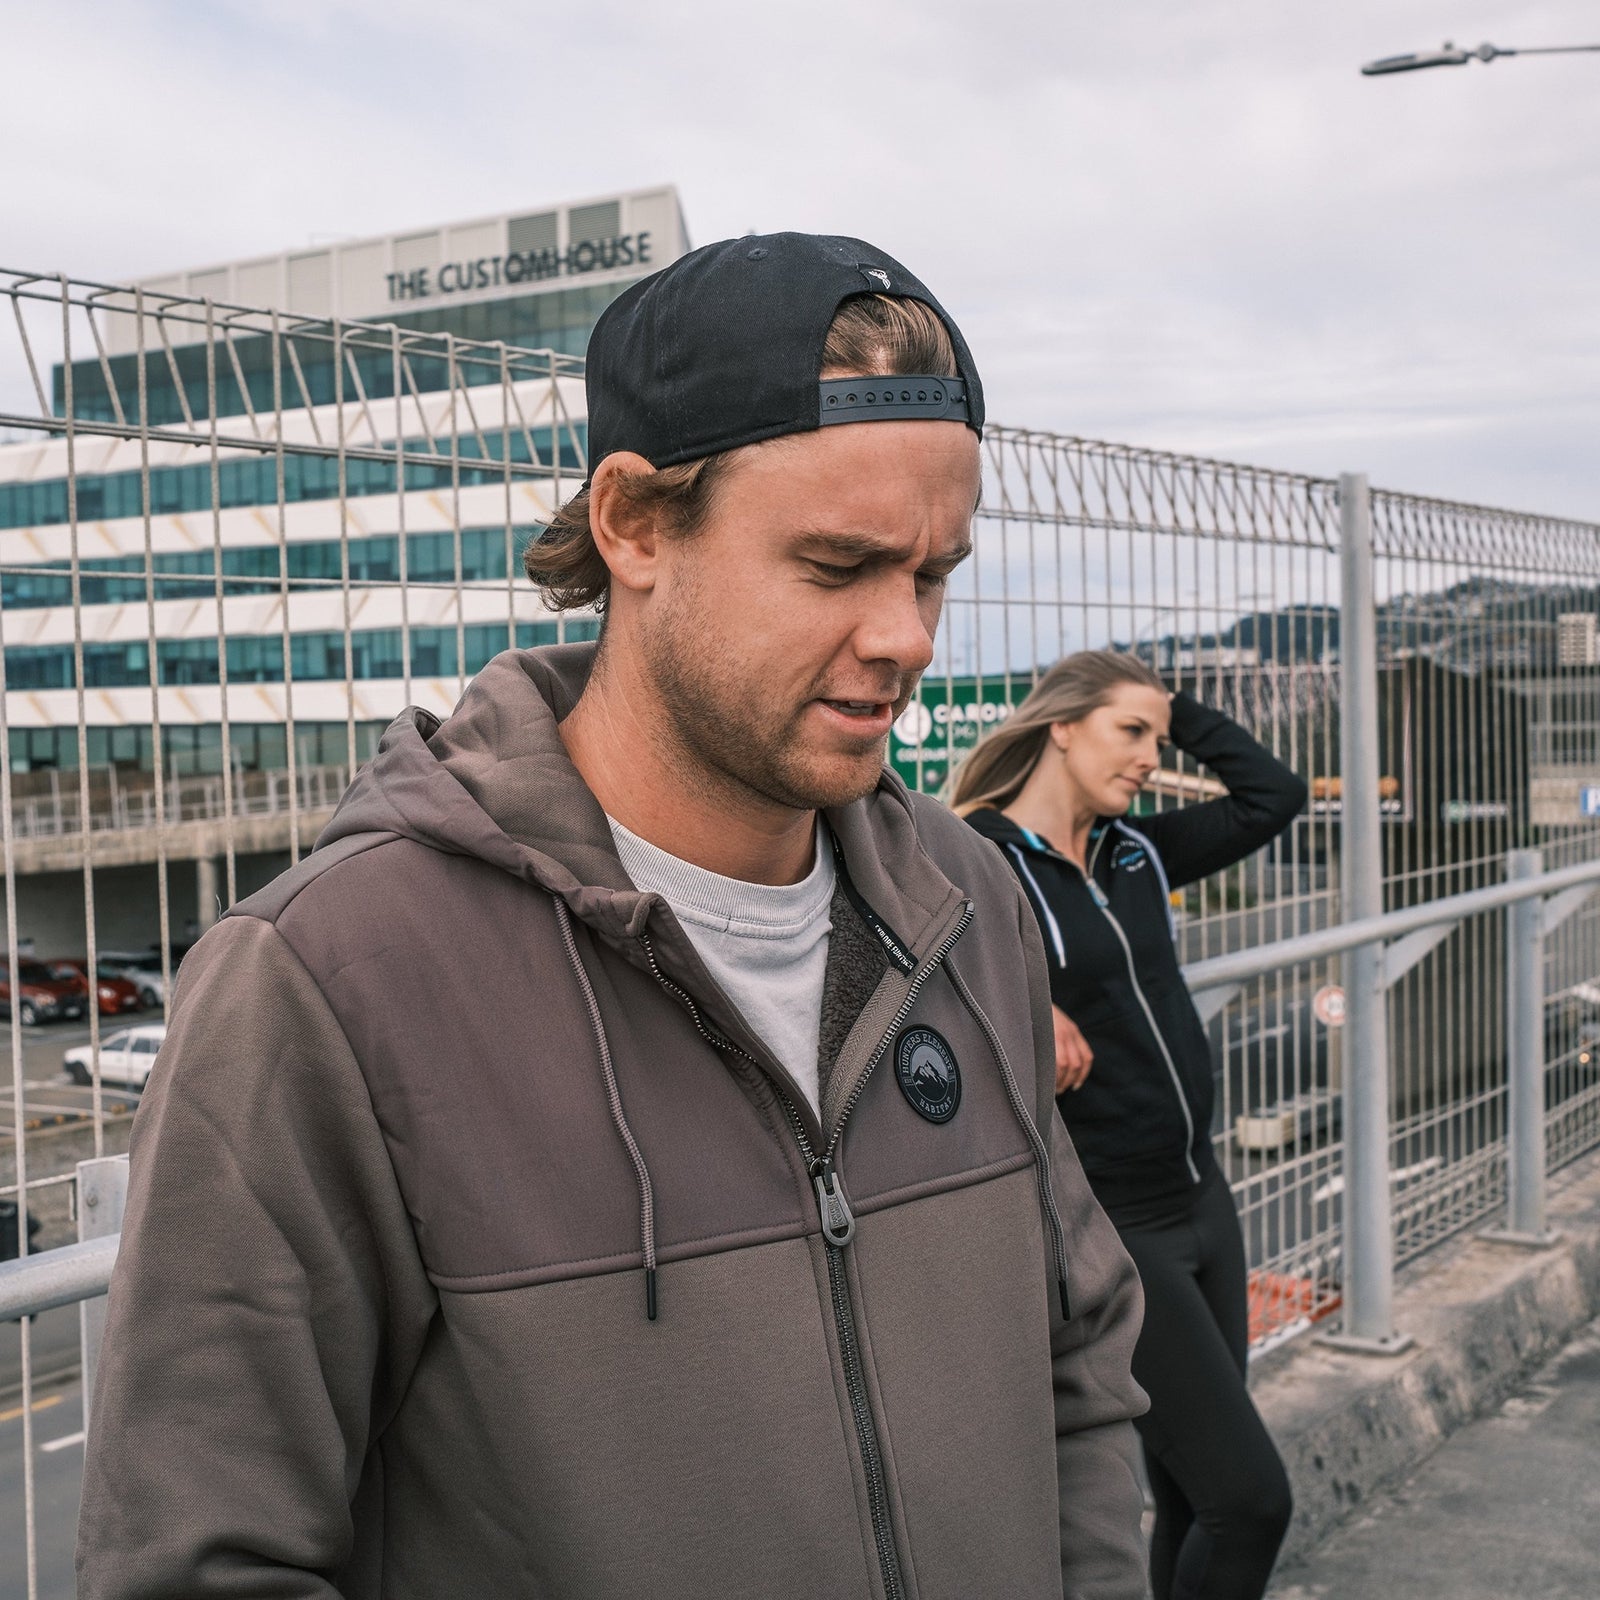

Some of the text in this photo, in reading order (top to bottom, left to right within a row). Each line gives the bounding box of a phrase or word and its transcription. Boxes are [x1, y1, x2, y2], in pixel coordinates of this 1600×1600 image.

[384, 230, 652, 301] THE CUSTOMHOUSE
[902, 1033, 953, 1074] HUNTERS ELEMENT
